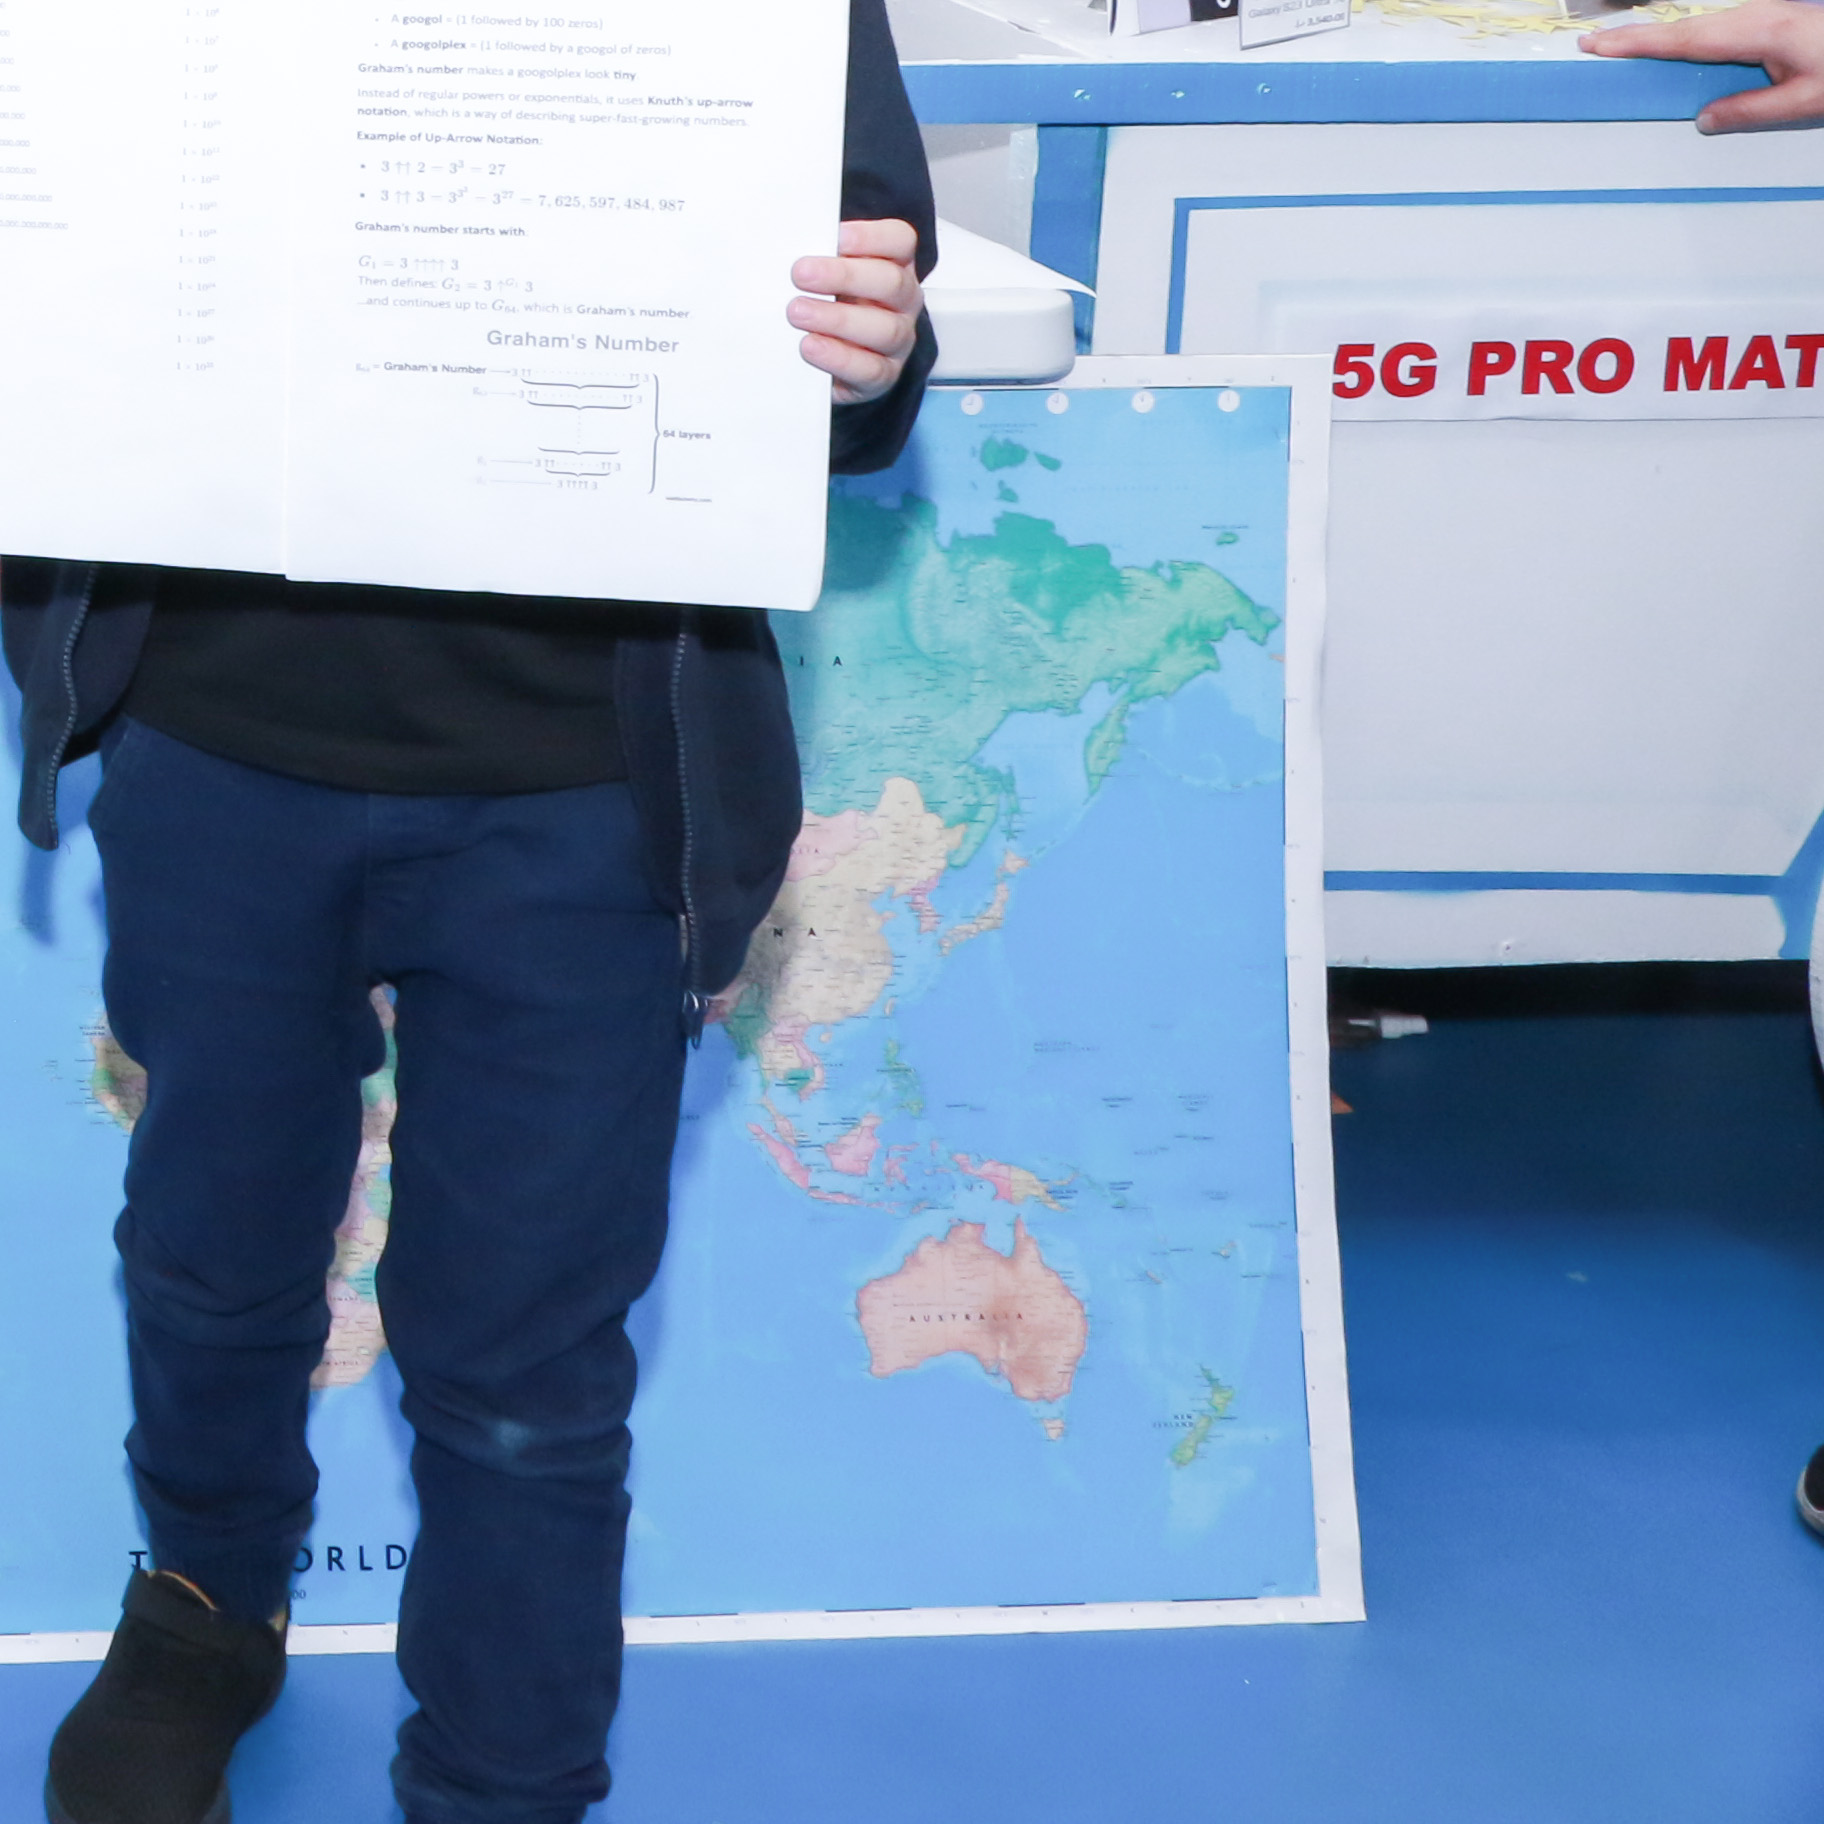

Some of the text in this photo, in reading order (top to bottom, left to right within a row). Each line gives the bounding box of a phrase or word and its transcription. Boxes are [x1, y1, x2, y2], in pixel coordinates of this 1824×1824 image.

[358, 63, 413, 74] Graham's
[417, 64, 464, 74] number
[467, 66, 504, 75] makes
[517, 68, 581, 79] googolplex
[585, 69, 610, 79] look
[358, 88, 400, 98] Instead
[403, 89, 415, 98] of
[418, 90, 458, 101] regular
[462, 93, 504, 101] powers
[524, 95, 602, 105] exponentials,
[606, 96, 614, 104] it
[648, 96, 694, 106] Knuth's
[697, 99, 753, 108] up-arrow
[357, 131, 406, 142] Example
[409, 132, 422, 141] of
[425, 133, 483, 143] Up-Arrow
[355, 221, 409, 232] Graham's
[413, 224, 459, 234] number
[463, 226, 495, 235] starts
[487, 329, 679, 352] Graham's Number
[1332, 333, 1824, 400] 5G PRO MAT
[909, 1313, 1023, 1322] AUSTRALIA
[290, 1543, 408, 1574] ORLD
